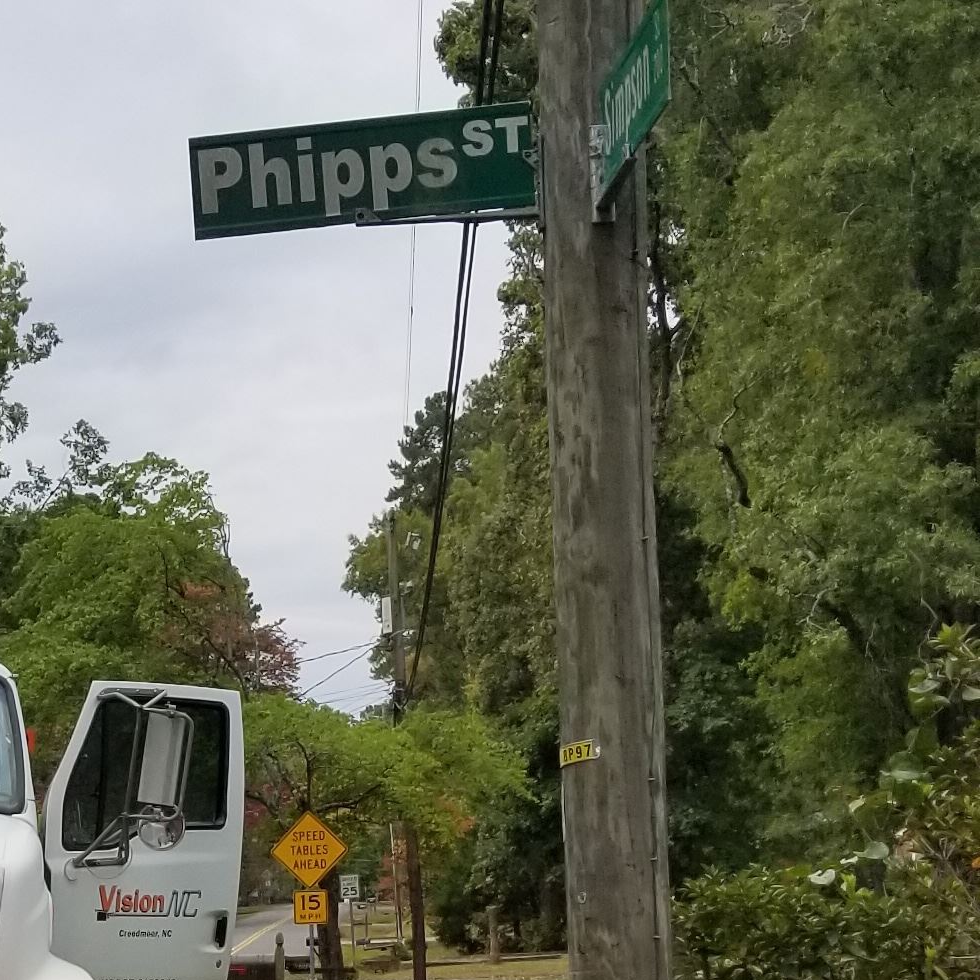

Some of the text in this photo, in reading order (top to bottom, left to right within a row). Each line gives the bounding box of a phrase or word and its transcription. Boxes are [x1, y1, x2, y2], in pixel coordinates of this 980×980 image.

[604, 44, 651, 156] Simpson
[197, 115, 528, 217] Phipps ST
[292, 831, 325, 841] SPEED
[290, 845, 329, 856] TABLES
[293, 859, 327, 870] AHEAD
[343, 887, 358, 896] 25
[300, 895, 321, 911] 15
[161, 930, 173, 938] NC
